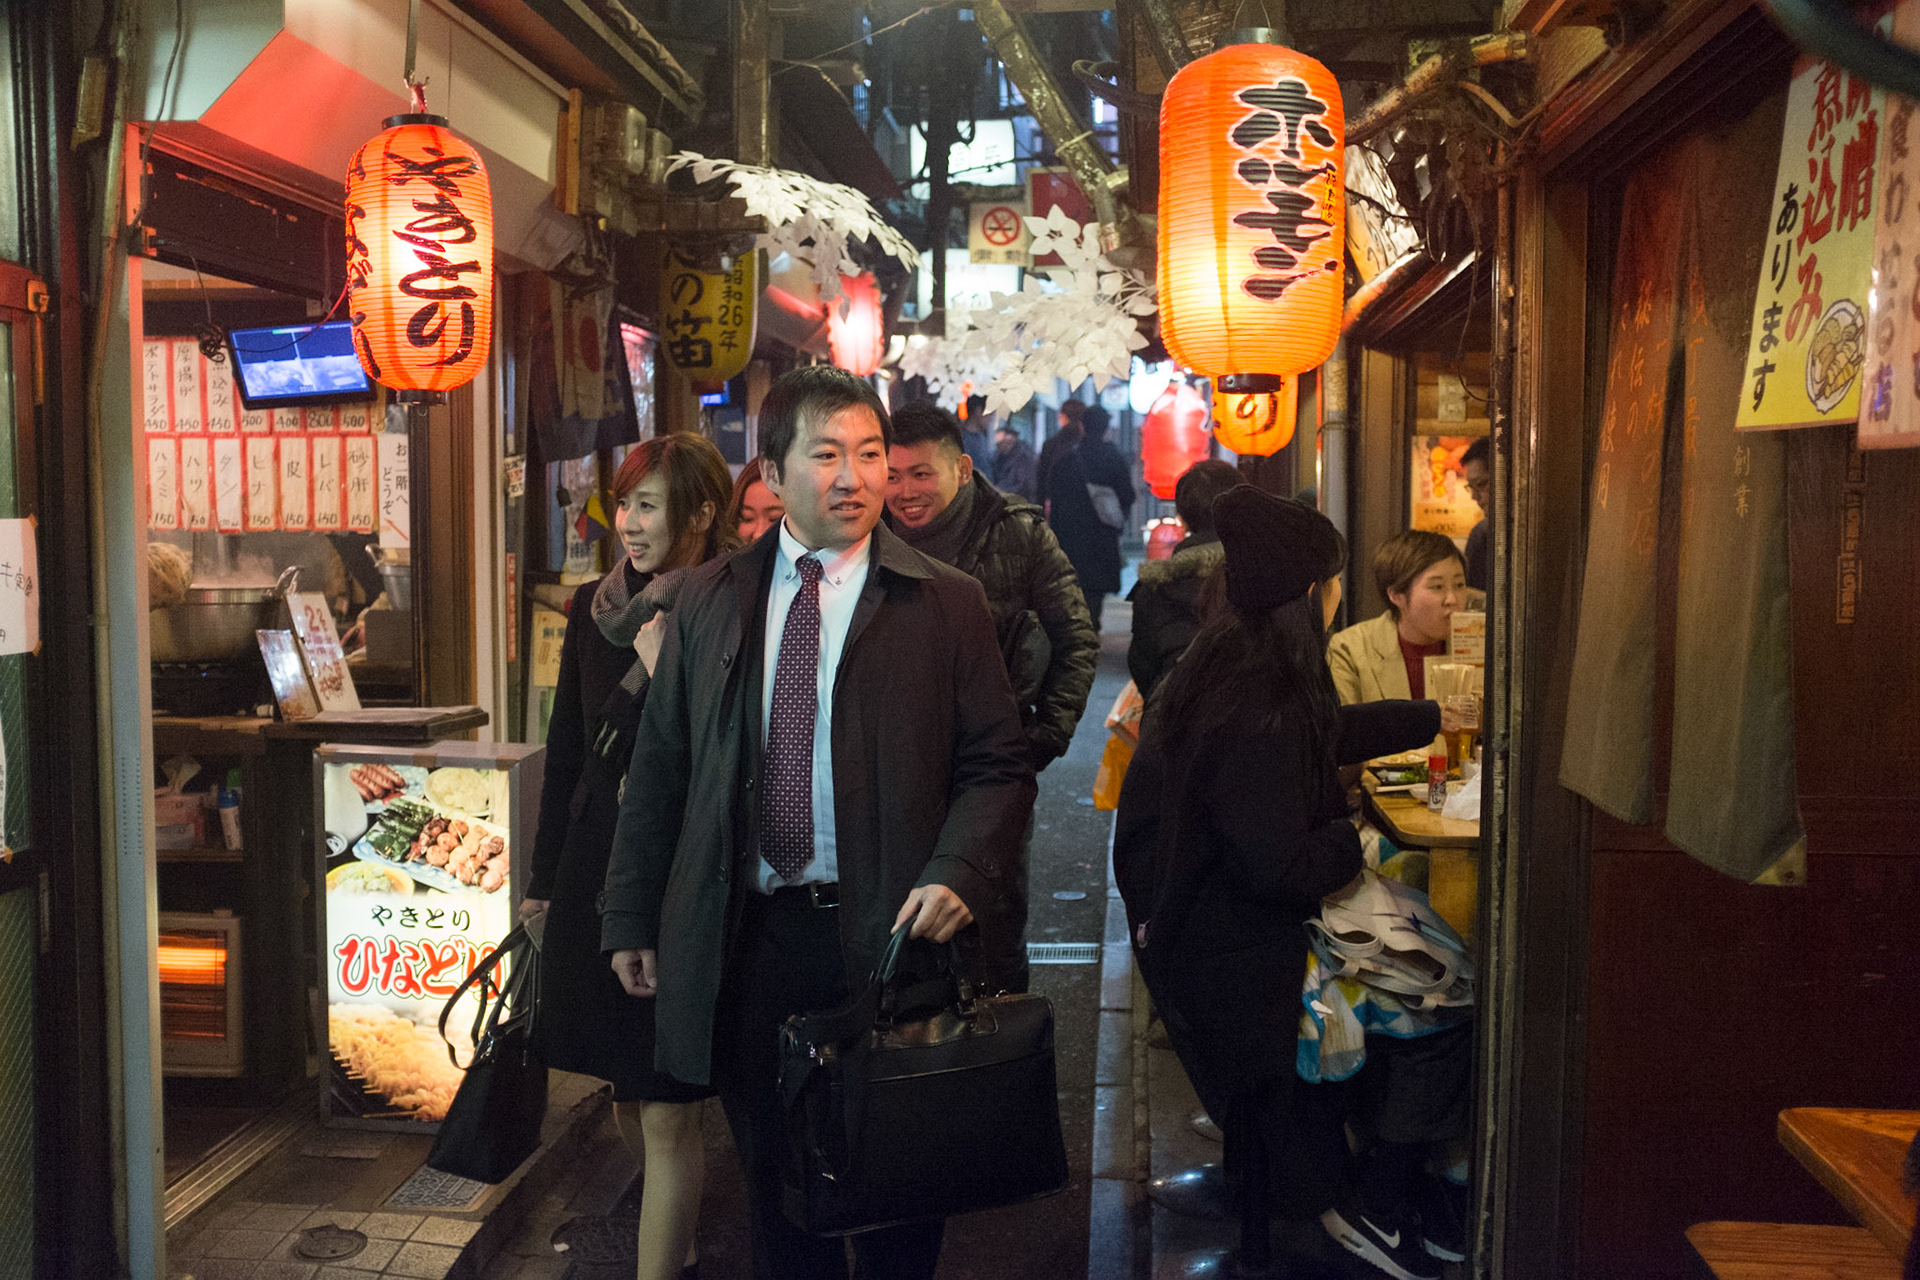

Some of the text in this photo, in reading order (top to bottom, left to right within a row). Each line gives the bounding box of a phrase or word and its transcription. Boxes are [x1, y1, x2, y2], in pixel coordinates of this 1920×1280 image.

[1231, 78, 1338, 301] ホルモン
[386, 147, 482, 368] やきとり
[664, 250, 713, 368] の笛
[1752, 183, 1799, 412] あります
[145, 345, 166, 417] ポテトサラダ
[308, 411, 334, 428] 800
[154, 452, 168, 498] ハラミ
[186, 455, 203, 494] ハツ
[252, 455, 266, 497] ヒナ
[286, 461, 301, 479] 皮
[318, 453, 334, 493] レバ
[382, 467, 394, 515] どうぞ
[395, 442, 409, 505] お二階へ
[252, 516, 271, 526] 150
[285, 514, 304, 526] 150
[350, 515, 371, 526] 150
[371, 905, 471, 932] やきとり
[335, 935, 504, 1003] ひなどり
